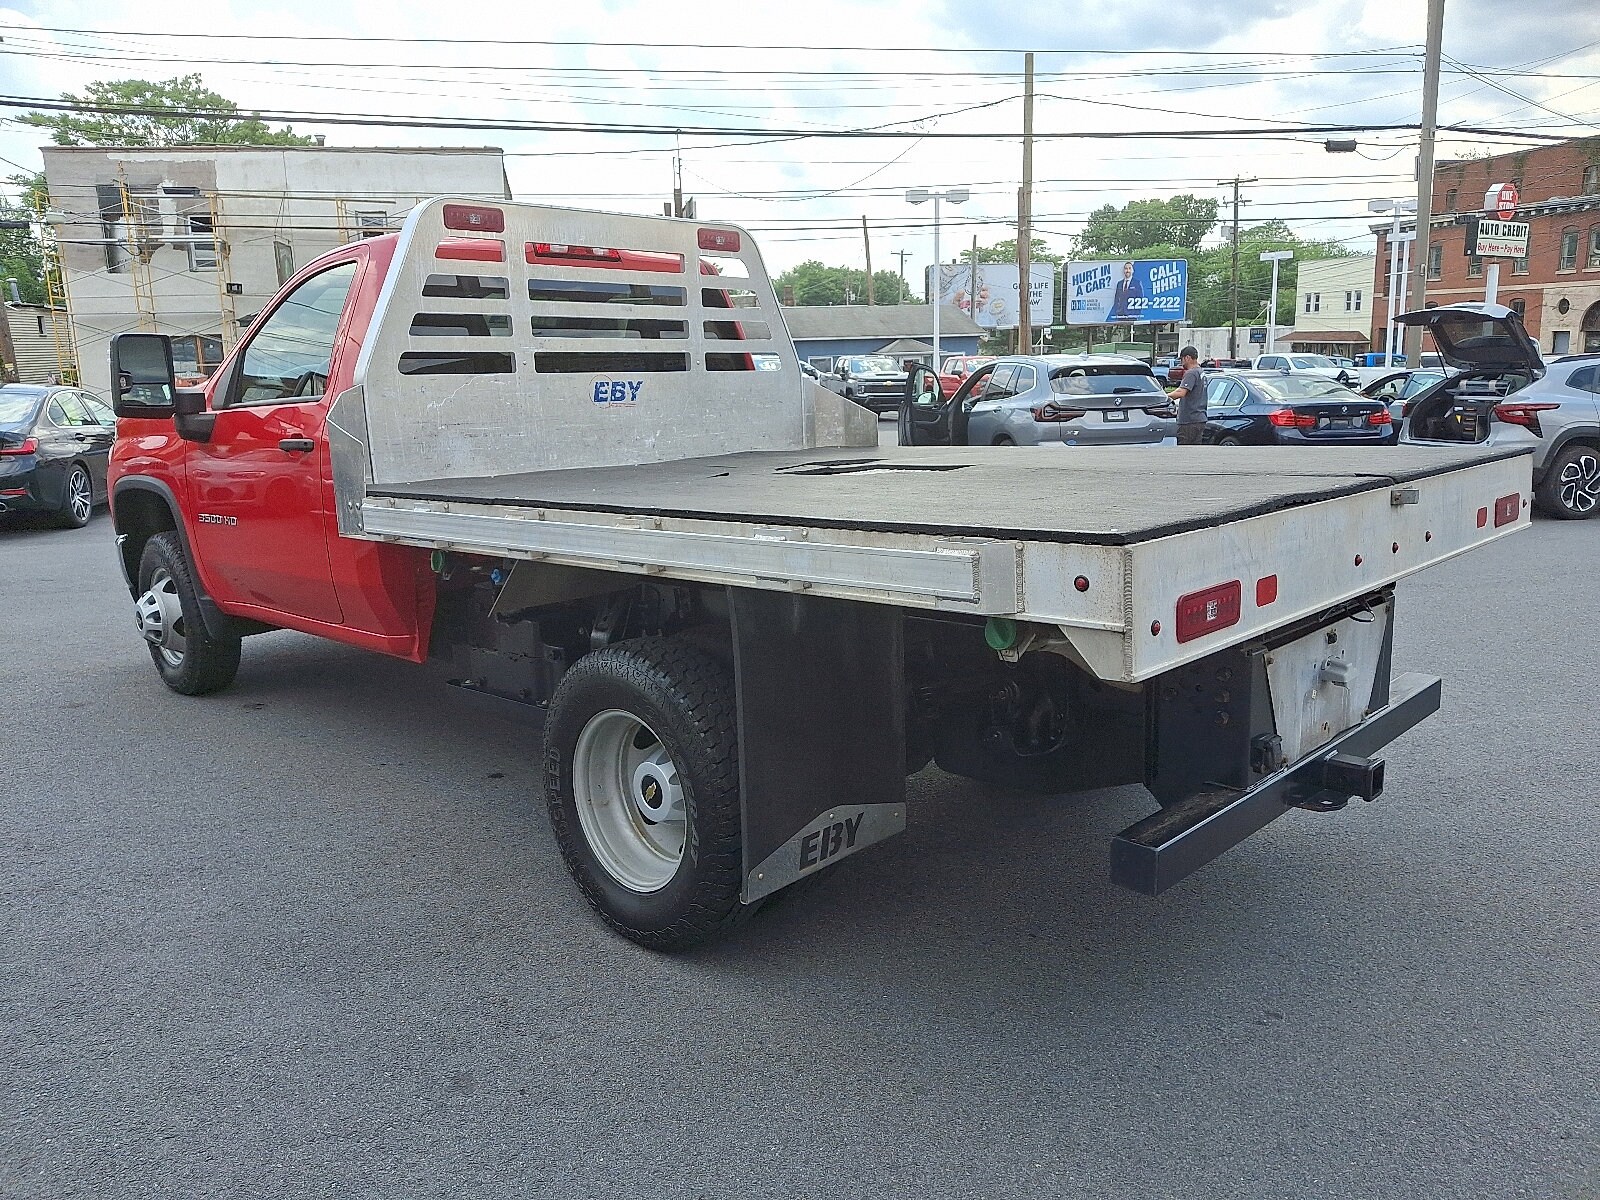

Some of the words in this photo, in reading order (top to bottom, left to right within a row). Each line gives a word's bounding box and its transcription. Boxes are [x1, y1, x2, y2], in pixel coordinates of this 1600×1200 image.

[1480, 223, 1499, 236] AUTO
[1502, 224, 1528, 238] CREDIT
[1477, 242, 1488, 253] Buy
[1488, 243, 1500, 252] Here
[1504, 244, 1513, 255] Pay
[1513, 245, 1525, 254] Here
[1072, 267, 1098, 287] HURT
[1100, 264, 1111, 278] IN
[1149, 261, 1180, 282] CALL
[1075, 285, 1084, 297] A
[1085, 276, 1112, 294] CAR?
[1152, 273, 1182, 295] HHR!
[1127, 296, 1181, 310] 222-2222
[593, 380, 644, 403] EBY
[198, 513, 222, 524] 3500
[224, 515, 238, 526] HD
[799, 811, 865, 872] EBY
